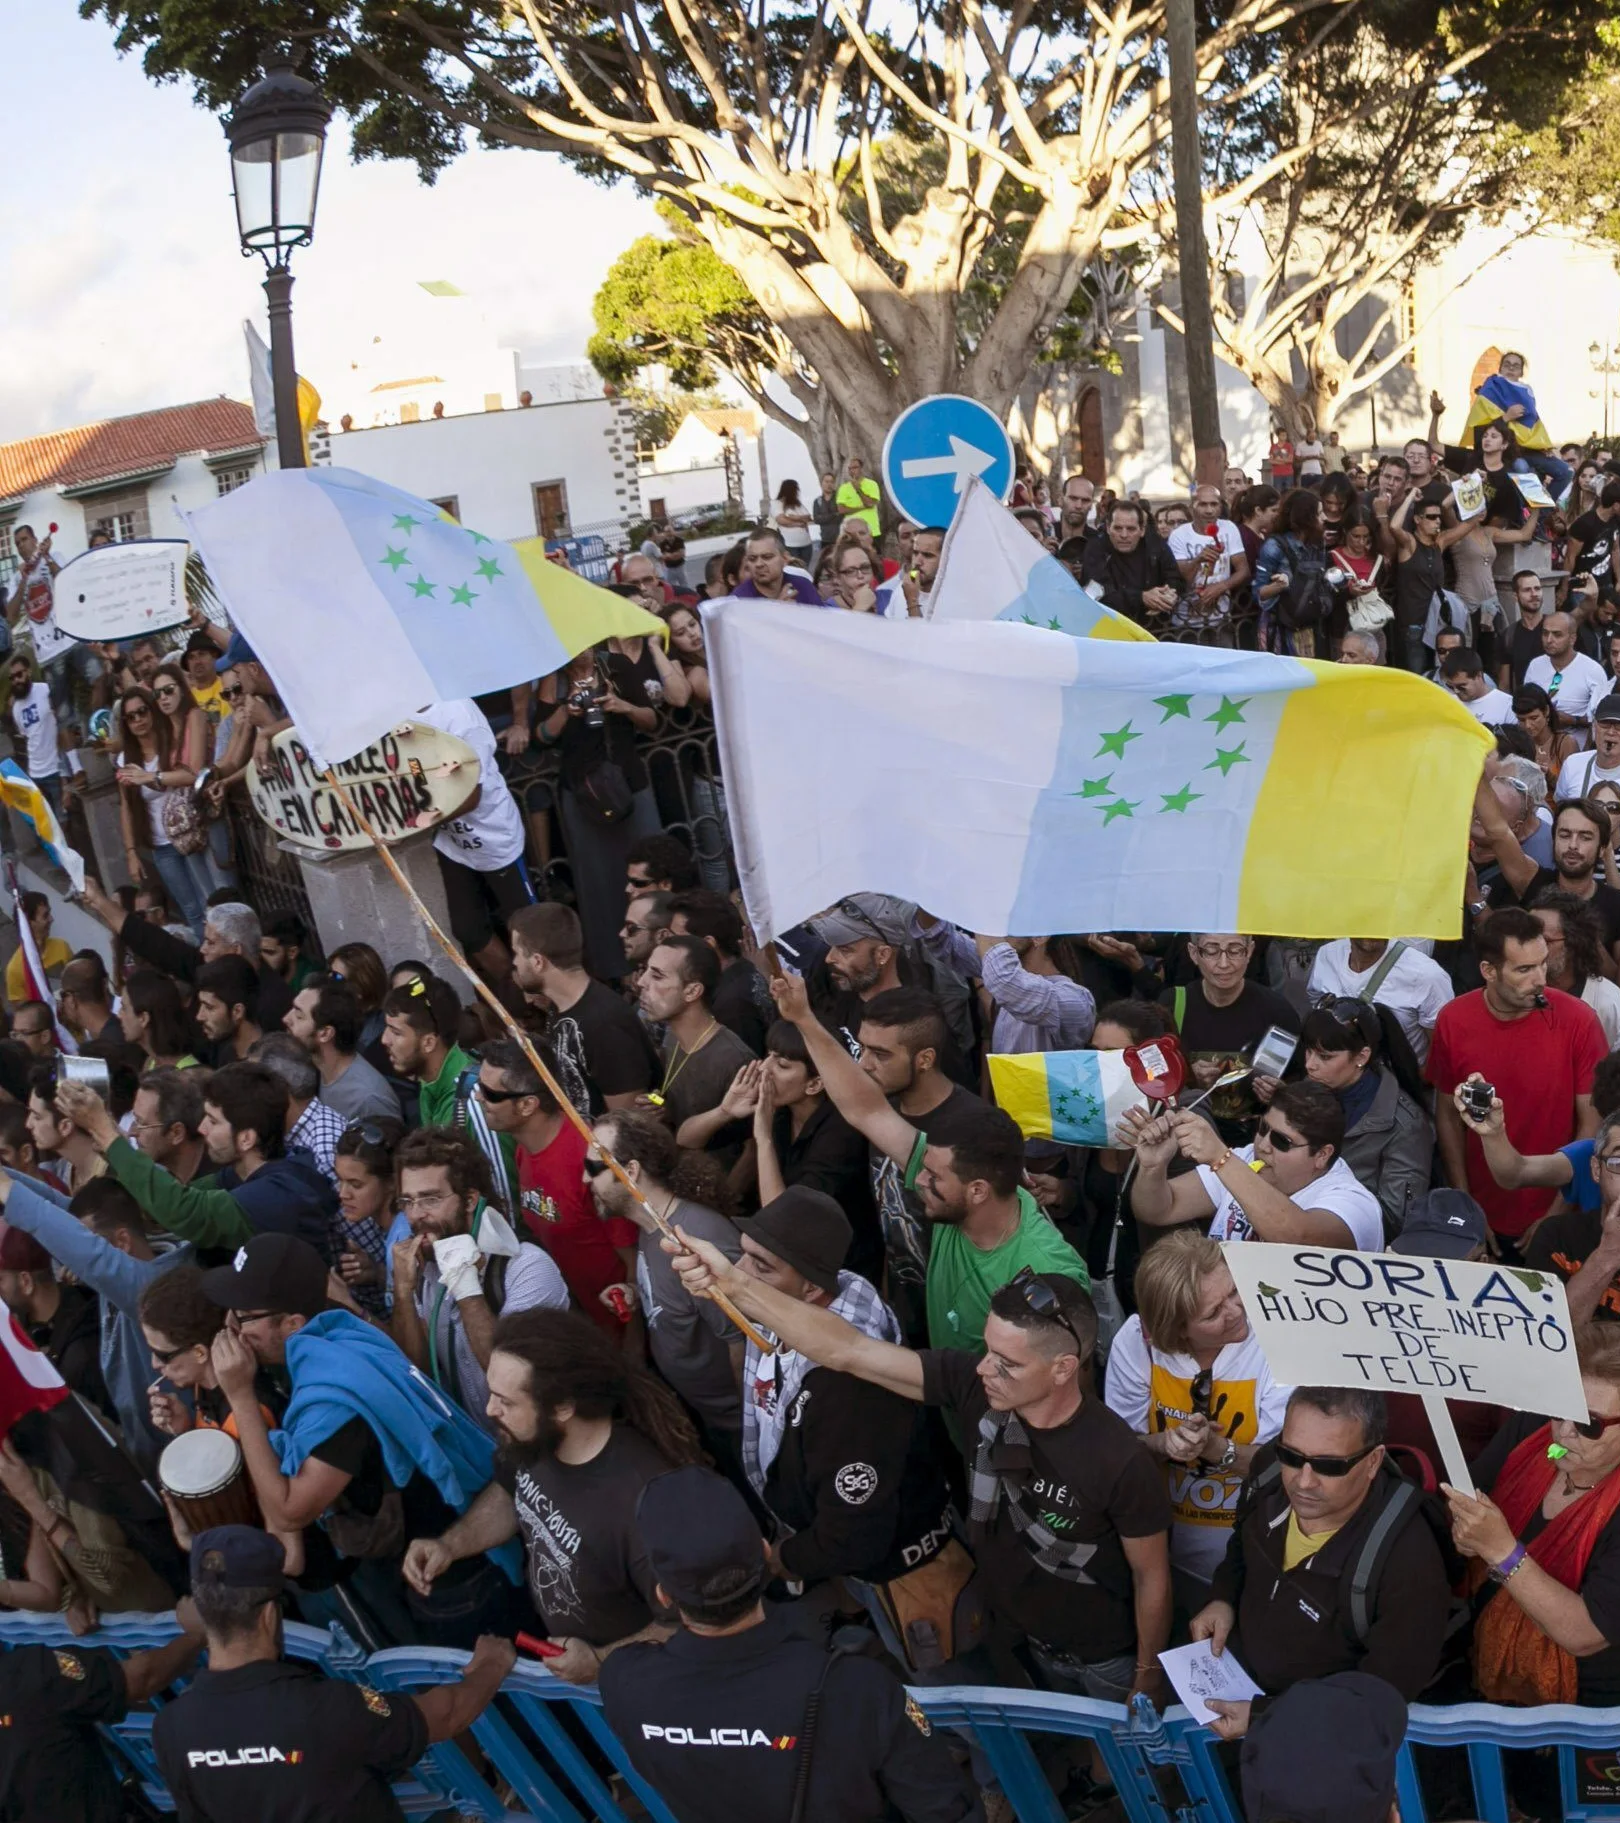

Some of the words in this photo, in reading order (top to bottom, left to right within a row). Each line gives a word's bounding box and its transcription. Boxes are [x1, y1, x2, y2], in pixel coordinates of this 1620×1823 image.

[1256, 1292, 1348, 1325] HIJO
[1391, 1331, 1449, 1360] DE
[1342, 1353, 1487, 1393] TELDE
[641, 1723, 772, 1746] POLICIA
[187, 1746, 286, 1768] POLICIA
